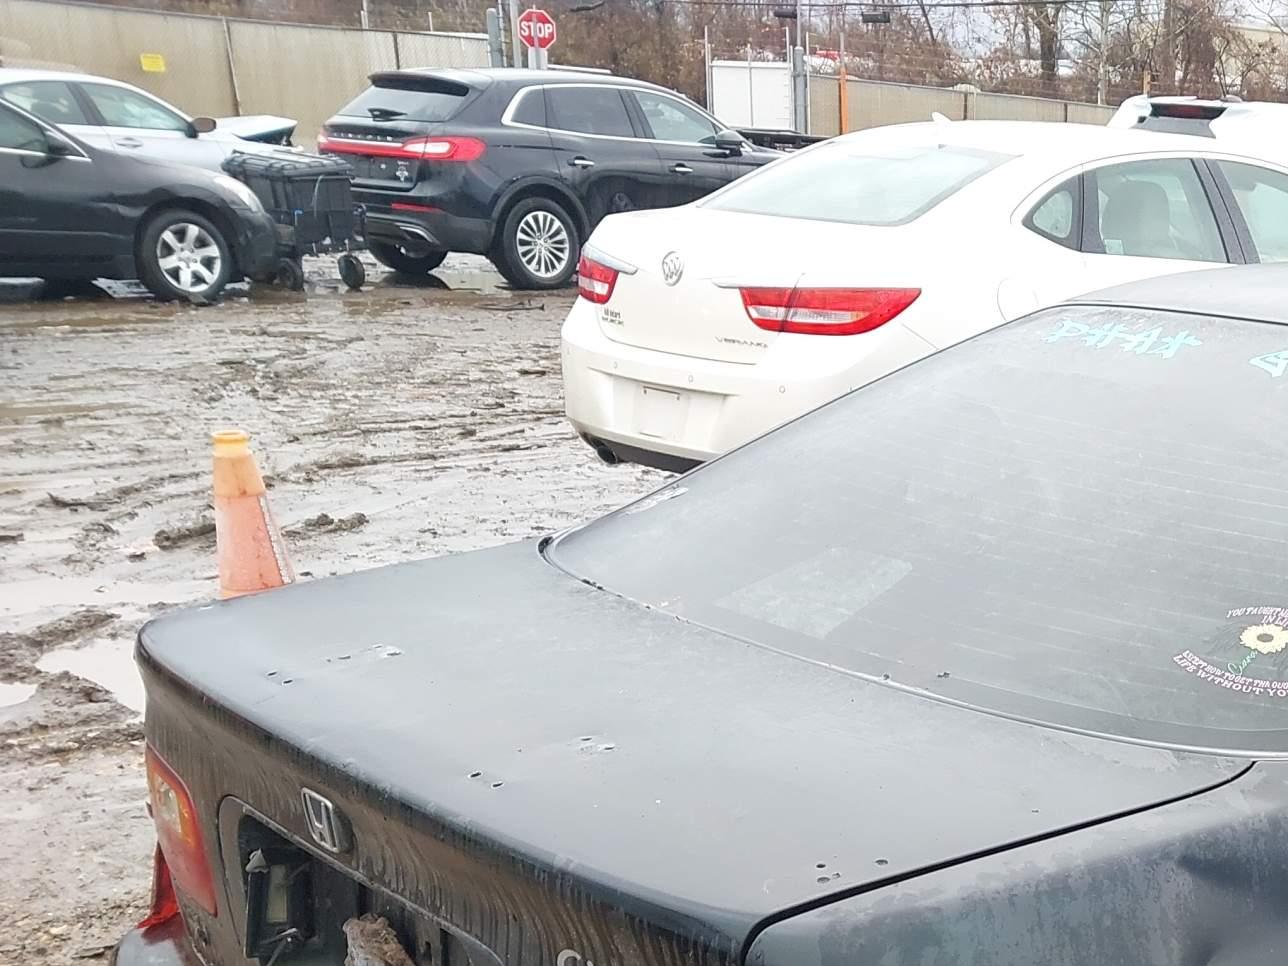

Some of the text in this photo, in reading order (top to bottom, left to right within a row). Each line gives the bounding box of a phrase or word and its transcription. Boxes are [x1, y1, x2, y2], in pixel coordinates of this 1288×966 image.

[520, 20, 553, 38] STOP
[1226, 607, 1246, 618] YOU
[1261, 615, 1276, 624] IN
[1173, 655, 1197, 673] LIFE
[1196, 671, 1264, 696] WITHOUT
